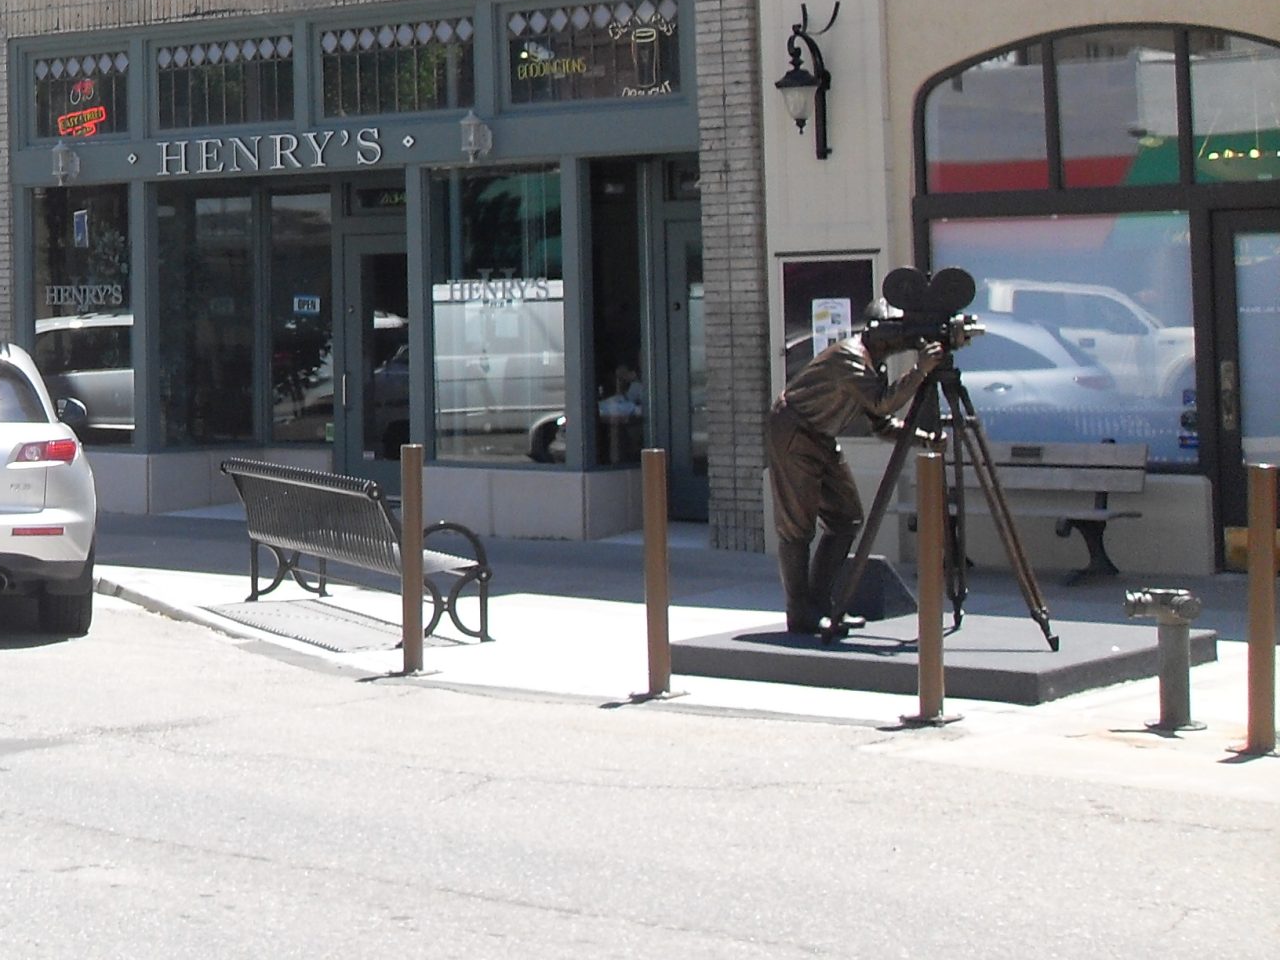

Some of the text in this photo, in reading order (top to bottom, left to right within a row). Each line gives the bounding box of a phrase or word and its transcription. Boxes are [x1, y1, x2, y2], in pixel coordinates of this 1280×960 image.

[517, 56, 587, 80] BODDINGTONS
[156, 127, 382, 176] HENRY'S
[45, 284, 122, 305] HENRY'S
[446, 277, 549, 301] HENRY'S
